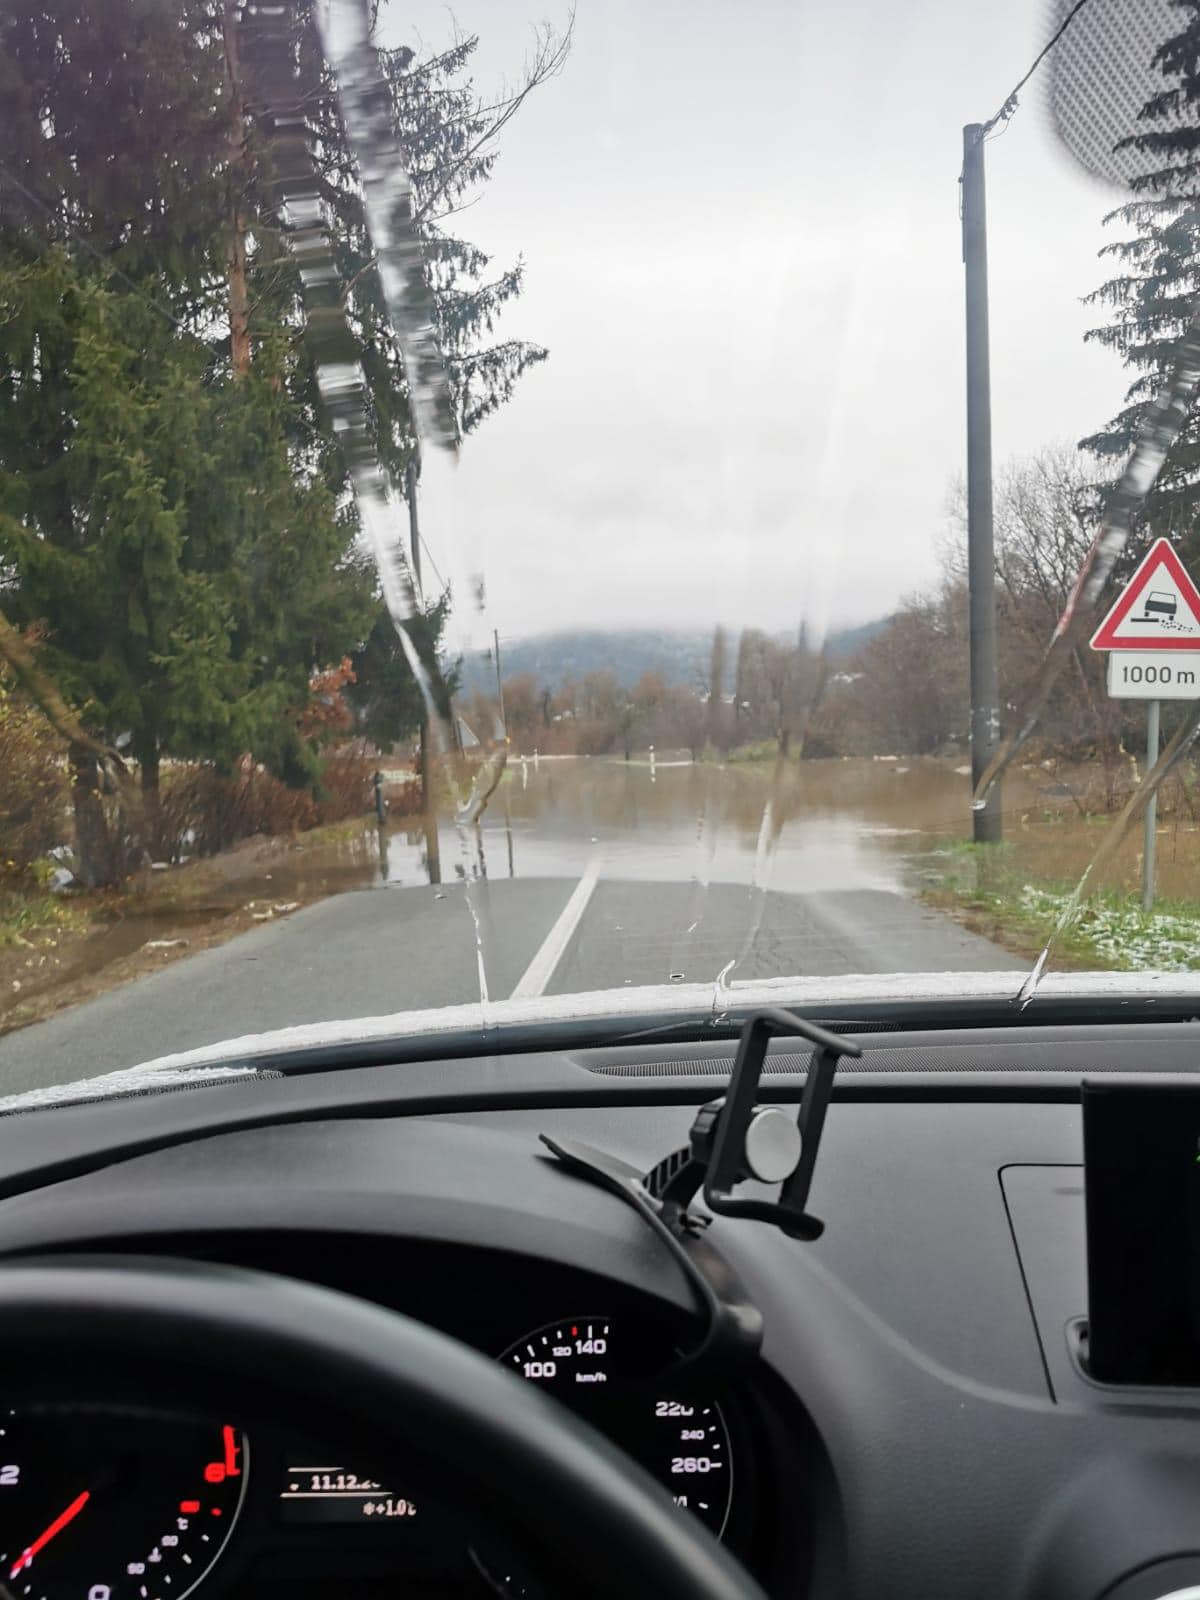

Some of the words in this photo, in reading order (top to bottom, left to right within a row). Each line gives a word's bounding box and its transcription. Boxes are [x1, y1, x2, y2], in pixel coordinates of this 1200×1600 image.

[1122, 666, 1172, 684] 1000
[1176, 671, 1196, 684] m
[552, 1346, 572, 1356] 120
[575, 1339, 606, 1354] 140
[523, 1362, 556, 1378] 100
[680, 1429, 705, 1440] 240
[671, 1457, 711, 1473] 260
[0, 1464, 20, 1485] 2
